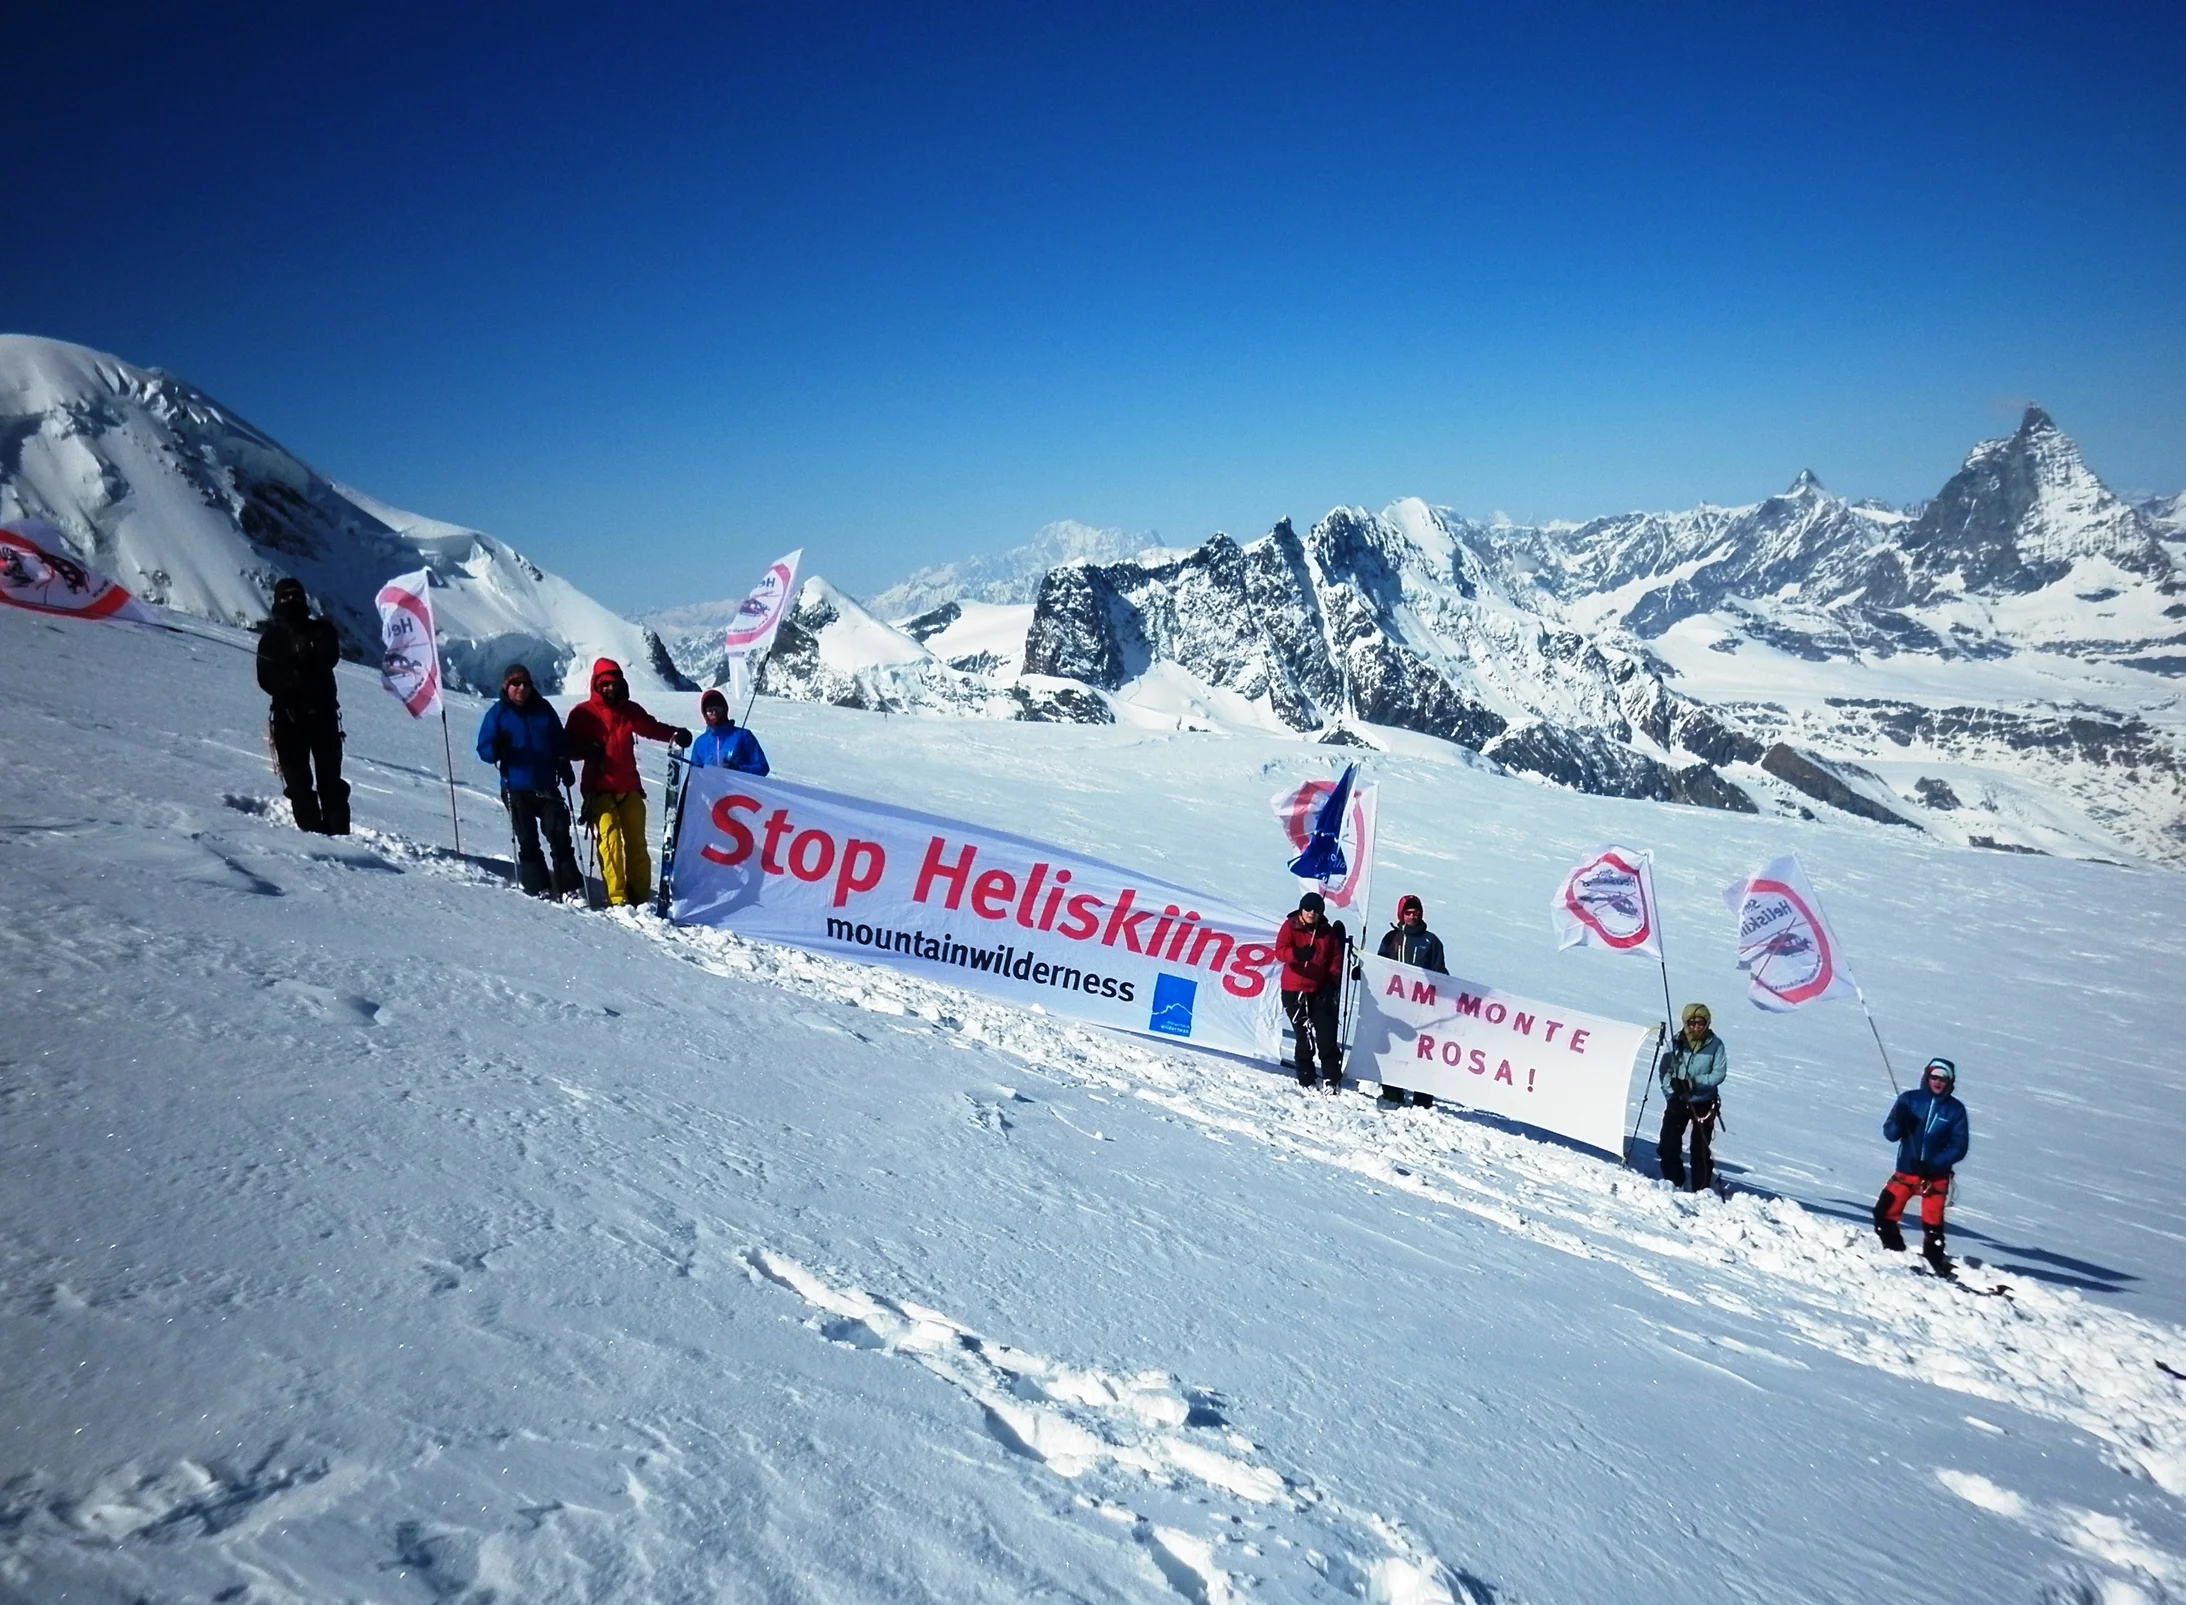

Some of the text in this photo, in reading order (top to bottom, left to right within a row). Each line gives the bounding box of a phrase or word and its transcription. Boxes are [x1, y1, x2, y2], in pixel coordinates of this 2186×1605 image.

[701, 795, 1276, 998] Stop Heliskiing
[826, 916, 1136, 1003] mountainwilderness
[1386, 974, 1592, 1055] AM MONTE
[1416, 1033, 1537, 1093] ROSA!
